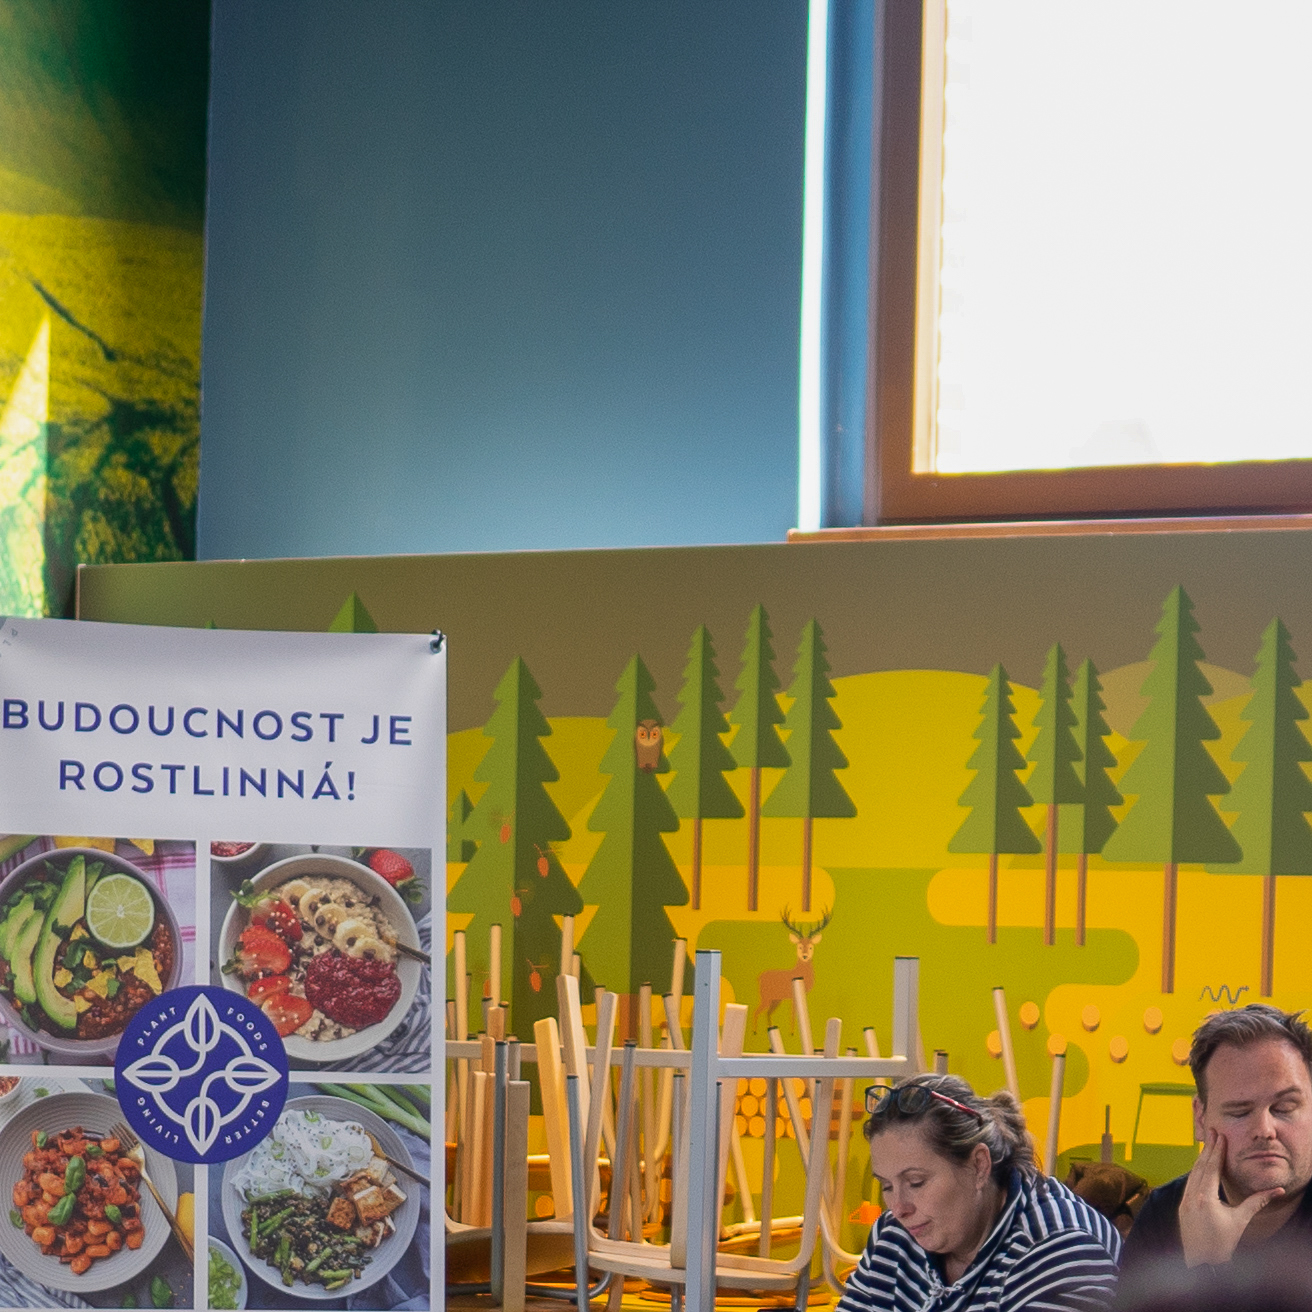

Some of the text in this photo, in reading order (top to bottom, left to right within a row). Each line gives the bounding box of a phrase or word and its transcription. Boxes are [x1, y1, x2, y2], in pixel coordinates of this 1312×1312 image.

[2, 698, 413, 746] BUDOUCNOST JE
[59, 759, 357, 801] ROSTLINNÁ!
[138, 1006, 268, 1051] PLANT FOODS
[137, 1097, 270, 1144] BETTER LIVING
